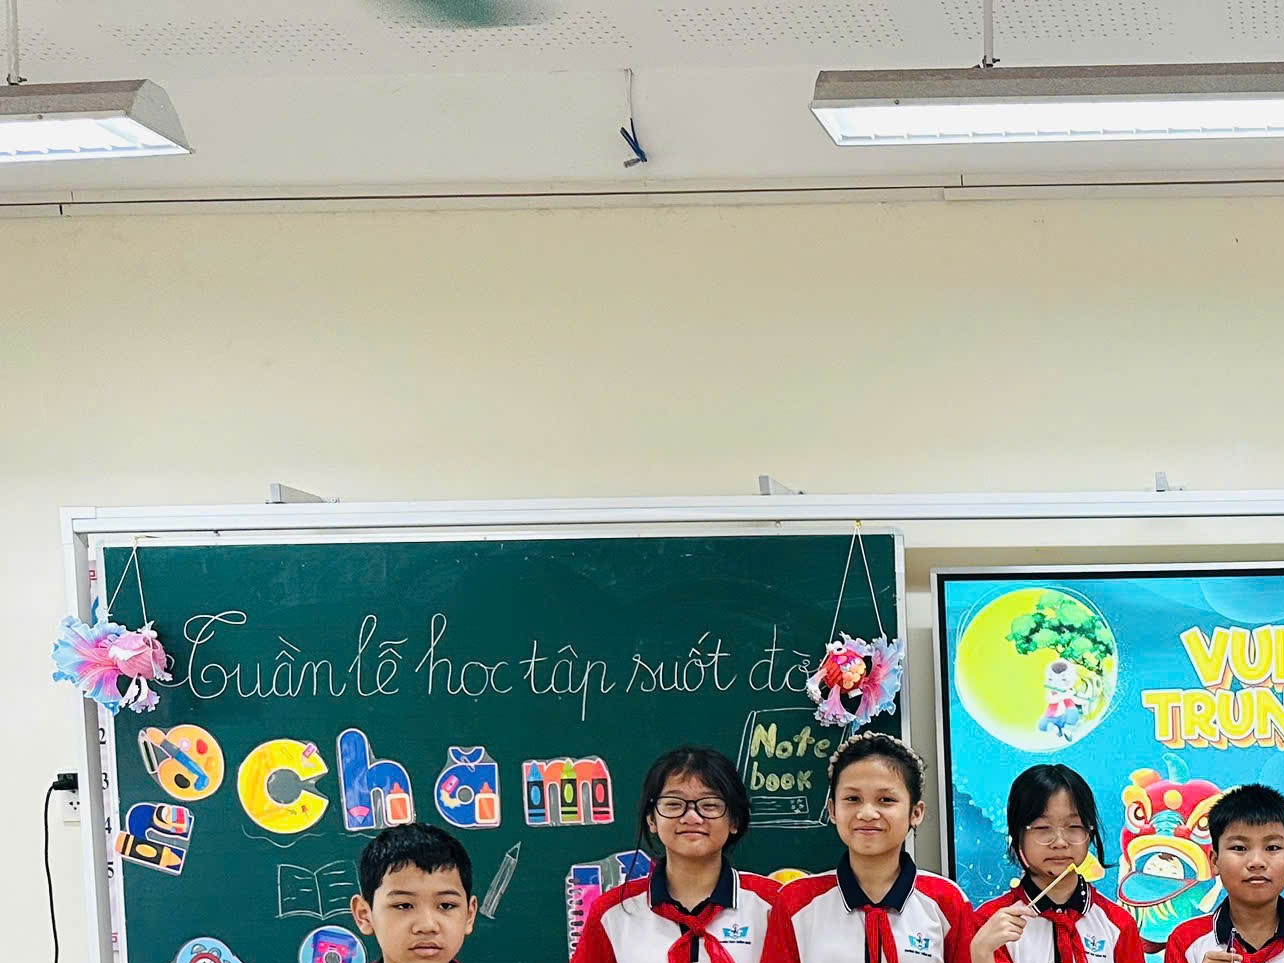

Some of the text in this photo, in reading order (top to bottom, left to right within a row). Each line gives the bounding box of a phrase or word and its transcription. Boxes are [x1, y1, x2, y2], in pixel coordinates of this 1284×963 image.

[184, 610, 346, 699] Tuần
[348, 614, 409, 698] lễ
[415, 612, 512, 703] học
[626, 631, 738, 693] suốt
[749, 623, 822, 693] đờ
[750, 723, 831, 759] Note
[750, 761, 814, 792] book
